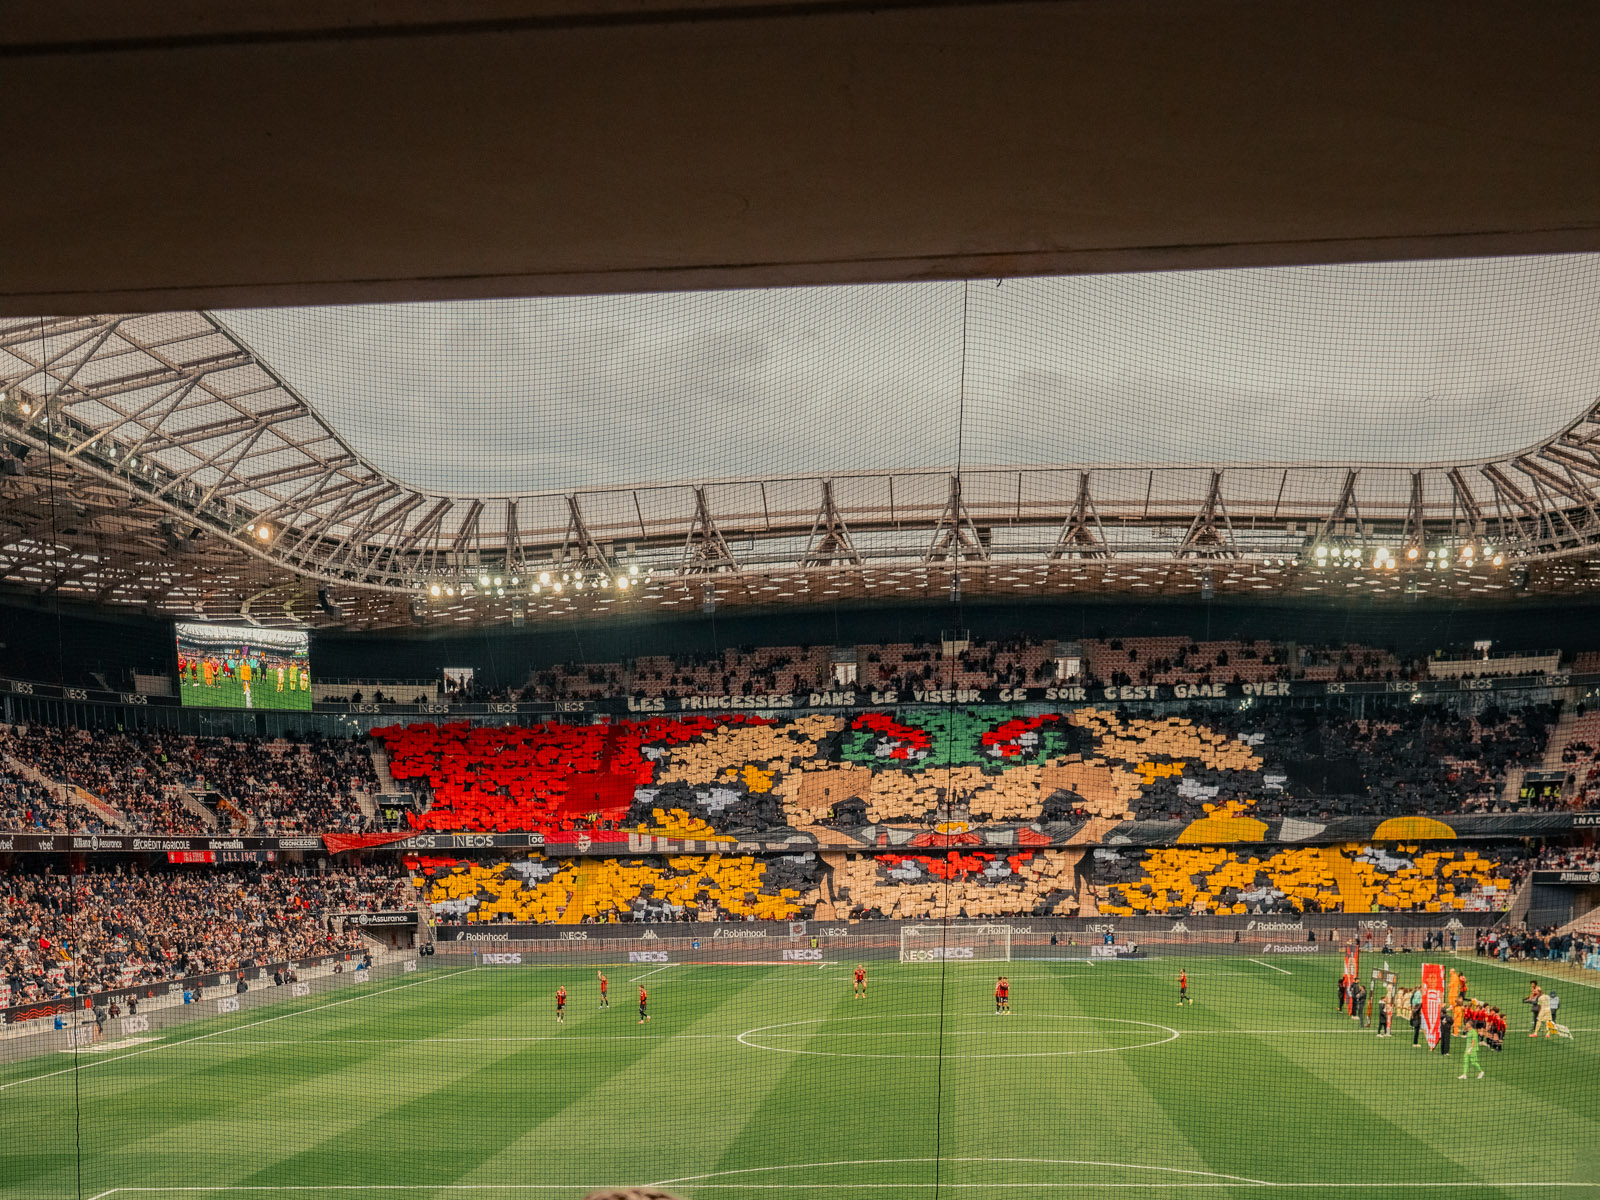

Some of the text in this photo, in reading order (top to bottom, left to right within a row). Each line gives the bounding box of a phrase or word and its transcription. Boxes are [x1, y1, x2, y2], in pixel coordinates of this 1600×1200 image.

[11, 681, 33, 695] INEOS
[1386, 682, 1418, 692] INEOS
[1460, 679, 1493, 689] INEOS
[63, 688, 88, 700] INEOS
[121, 693, 148, 705] INEOS
[627, 695, 665, 712] LES
[681, 693, 793, 709] PRINCESSES
[809, 691, 855, 707] DANS
[871, 690, 899, 704] LE
[1046, 686, 1088, 701] SOIR
[1174, 683, 1227, 698] GAME
[1242, 680, 1292, 697] OVER
[350, 703, 380, 713] INEOS
[419, 703, 449, 713] INEOS
[487, 703, 517, 713] INEOS
[555, 702, 585, 712] INEOS
[73, 838, 91, 848] Allianz
[99, 838, 122, 849] Assurance
[139, 838, 162, 850] CRÉDIT
[162, 840, 190, 850] AGRICOLE
[395, 836, 436, 848] INEOS
[453, 835, 494, 848] INEOS
[1560, 872, 1589, 881] Allianz
[372, 915, 408, 923] Assurance
[1358, 919, 1388, 929] INEOS
[987, 924, 1032, 935] Robihood
[1085, 923, 1115, 933] INEOS
[1257, 921, 1303, 931] Robinhood
[466, 932, 509, 941] Robinhood
[560, 931, 587, 940] INEOS
[723, 929, 767, 938] Robinhood
[820, 928, 848, 937] INEOS
[933, 946, 974, 959] INEOS
[1273, 944, 1319, 953] Robinhood
[482, 953, 522, 965] INEOS
[629, 951, 669, 963] INEOS
[782, 949, 823, 961] INEOS
